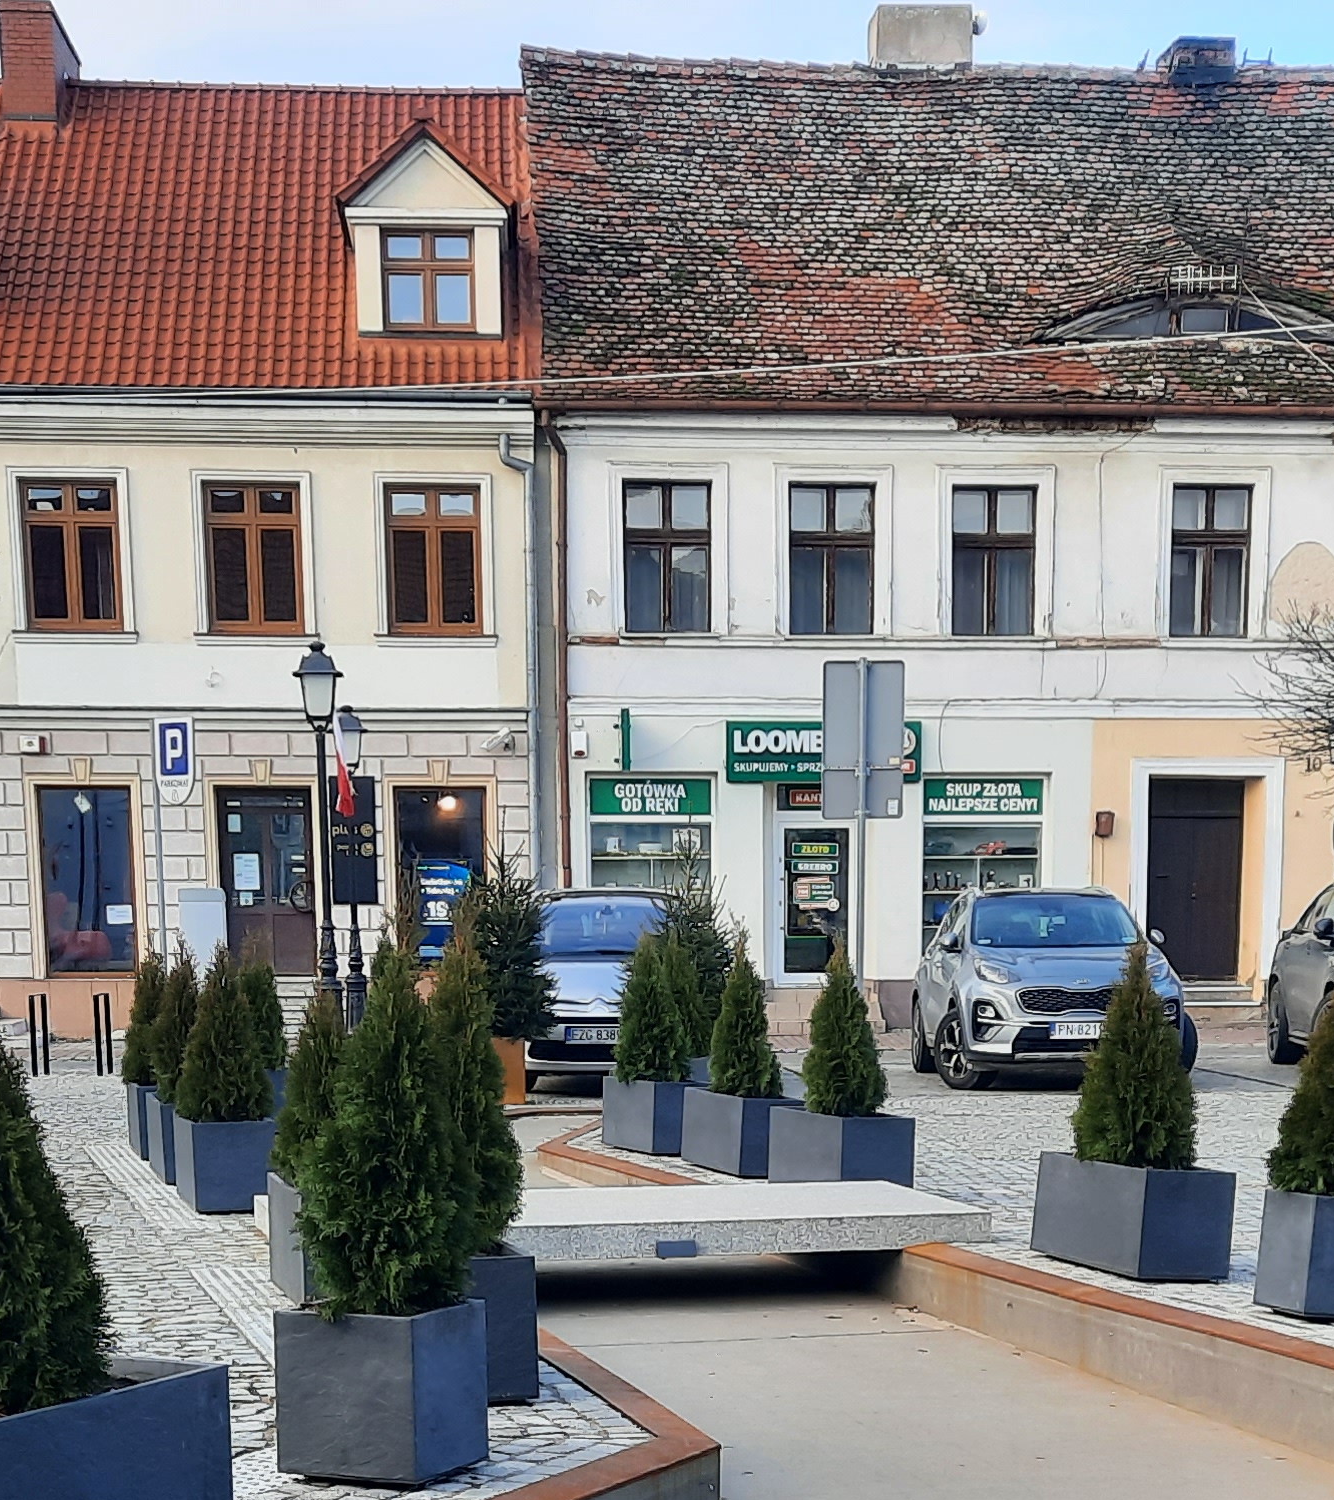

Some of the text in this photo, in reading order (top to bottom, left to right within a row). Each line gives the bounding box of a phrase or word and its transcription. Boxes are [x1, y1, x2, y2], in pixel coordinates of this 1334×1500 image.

[165, 728, 183, 770] P
[733, 730, 822, 754] LOOMB
[733, 761, 789, 773] SKUPUJEMY
[1305, 756, 1322, 771] 10
[614, 780, 686, 798] GOTÓWKA
[946, 783, 1022, 797] SKUP ZŁOTA
[621, 798, 679, 815] OD RĘKI
[928, 798, 998, 812] NAJLEPSZE
